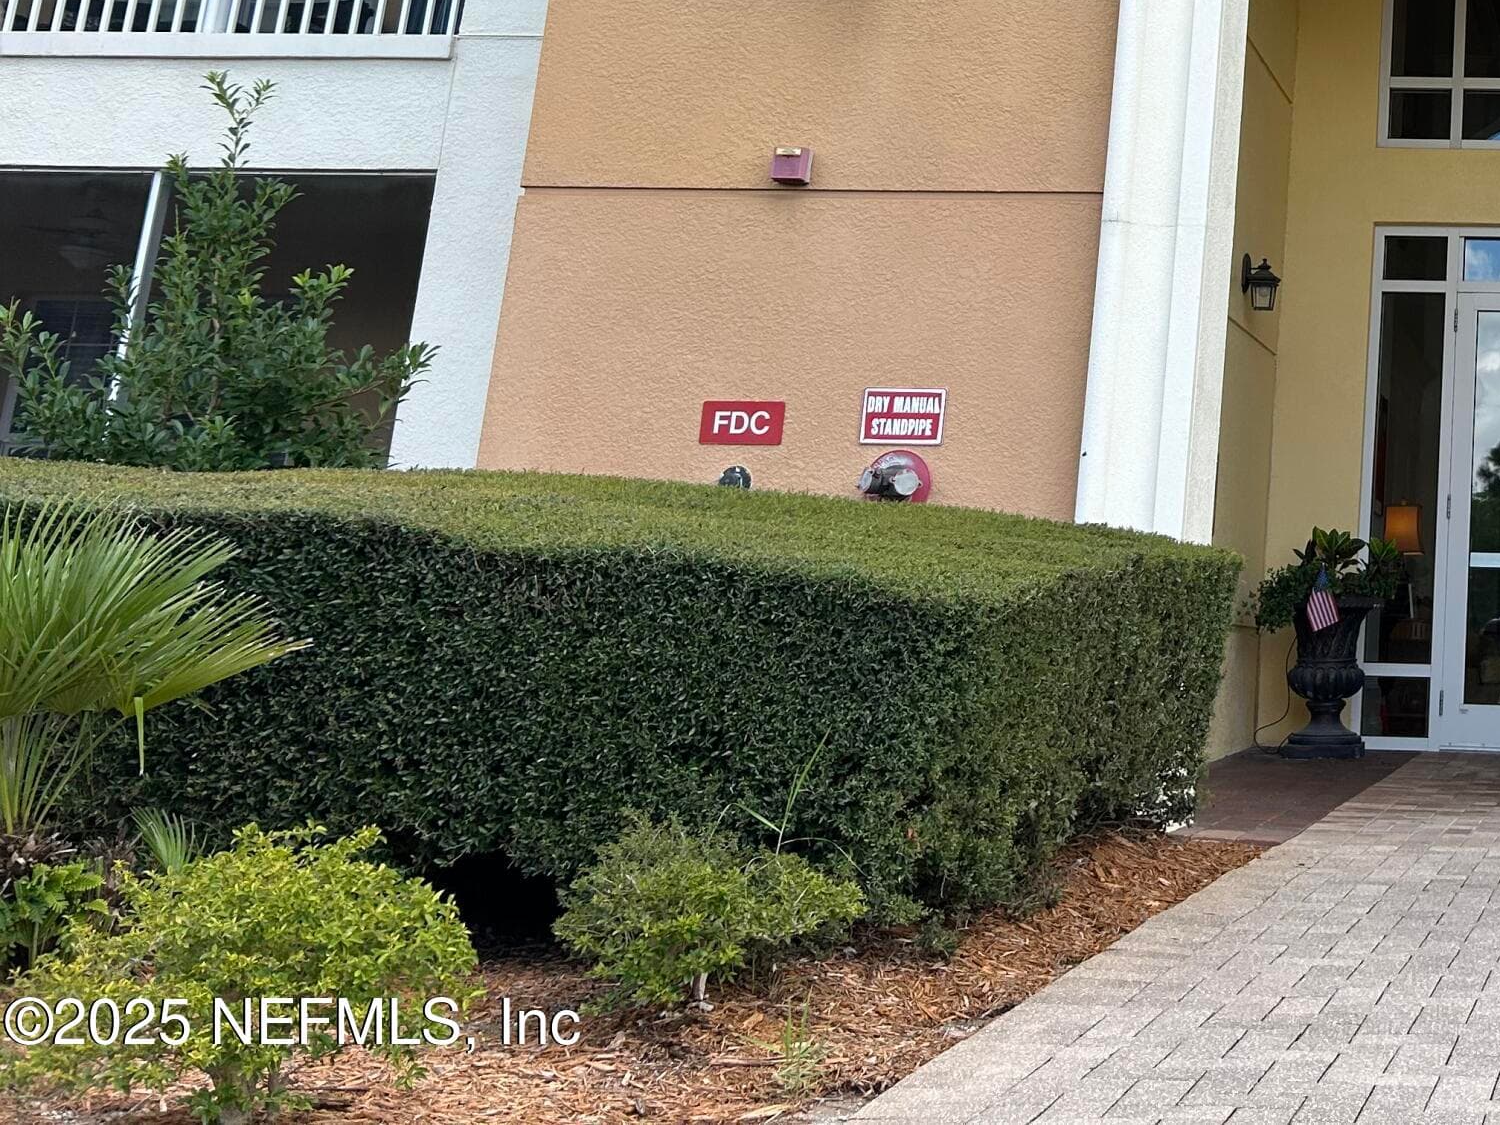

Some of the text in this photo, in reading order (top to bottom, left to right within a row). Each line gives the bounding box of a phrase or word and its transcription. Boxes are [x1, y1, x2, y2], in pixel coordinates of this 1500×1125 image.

[867, 396, 940, 413] DRY MANUAL
[712, 411, 770, 434] FDC
[870, 418, 933, 435] STANDPIPE
